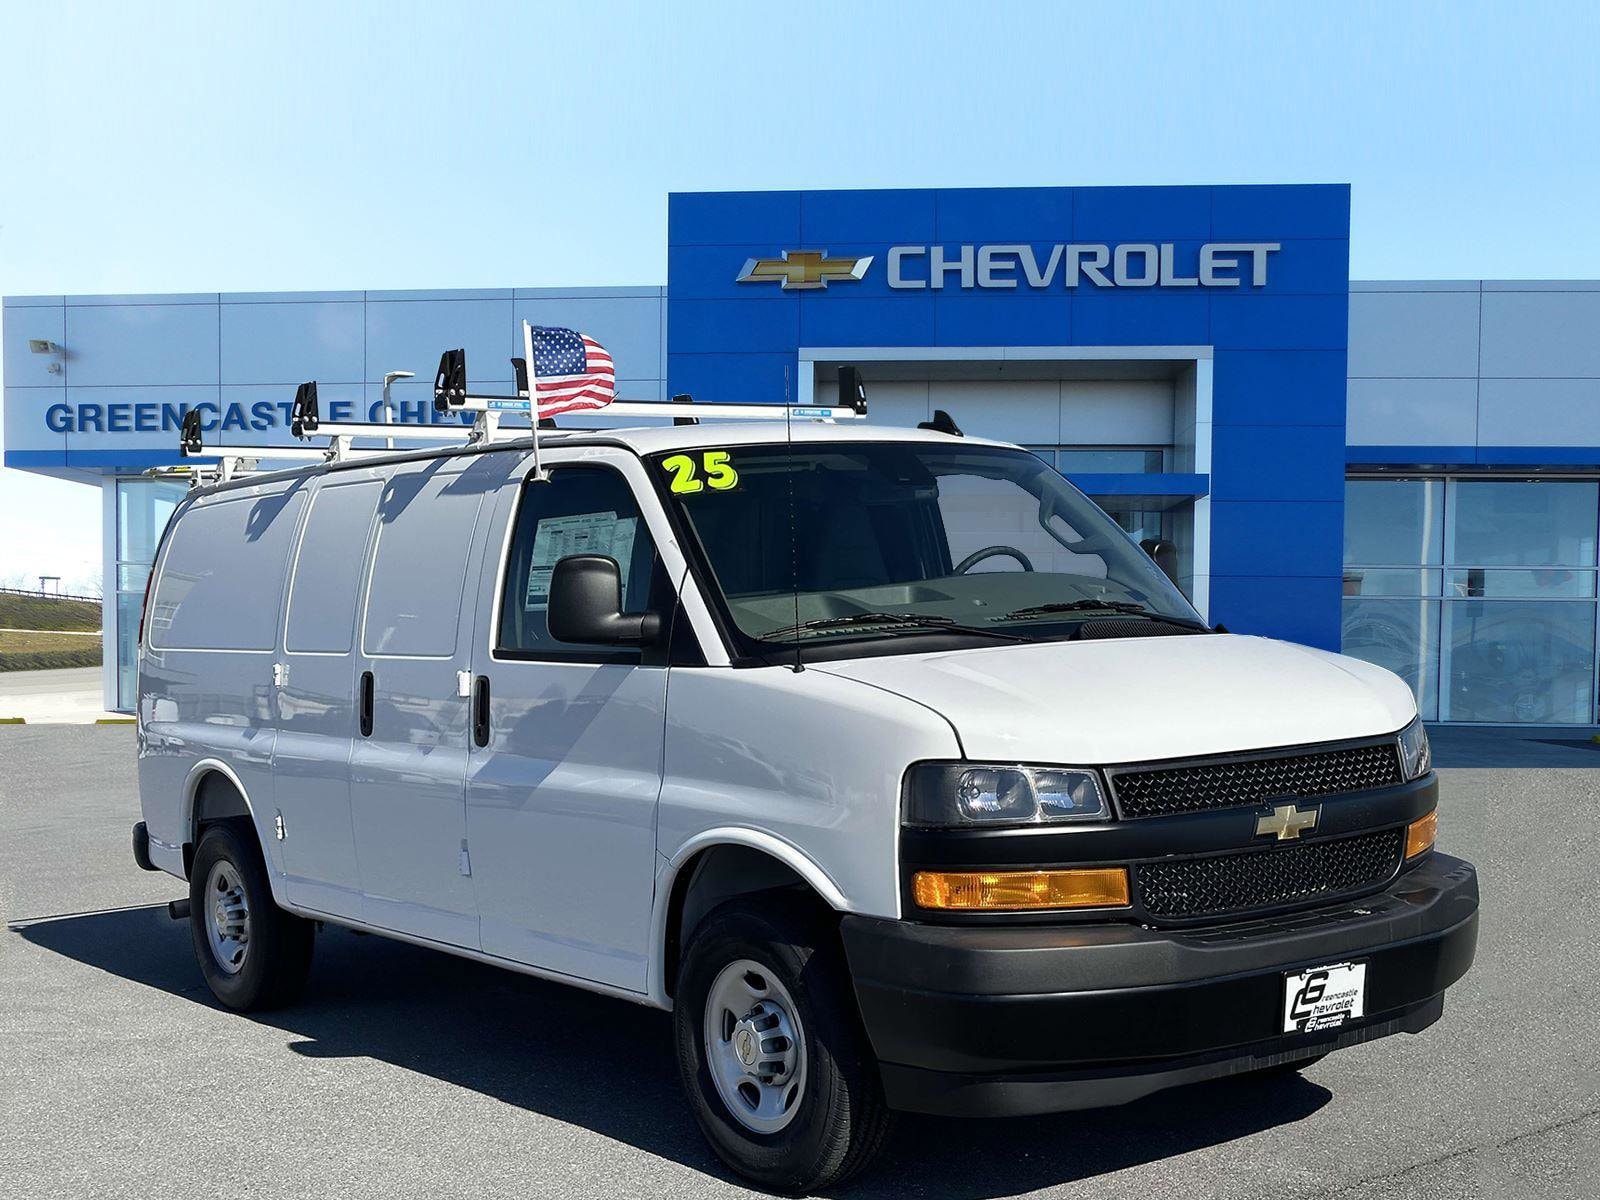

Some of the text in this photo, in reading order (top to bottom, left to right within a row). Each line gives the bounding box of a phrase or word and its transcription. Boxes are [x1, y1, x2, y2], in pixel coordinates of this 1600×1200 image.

[887, 243, 1281, 289] CHEVROLET
[46, 401, 352, 432] GREENCASTE
[661, 451, 739, 494] 25
